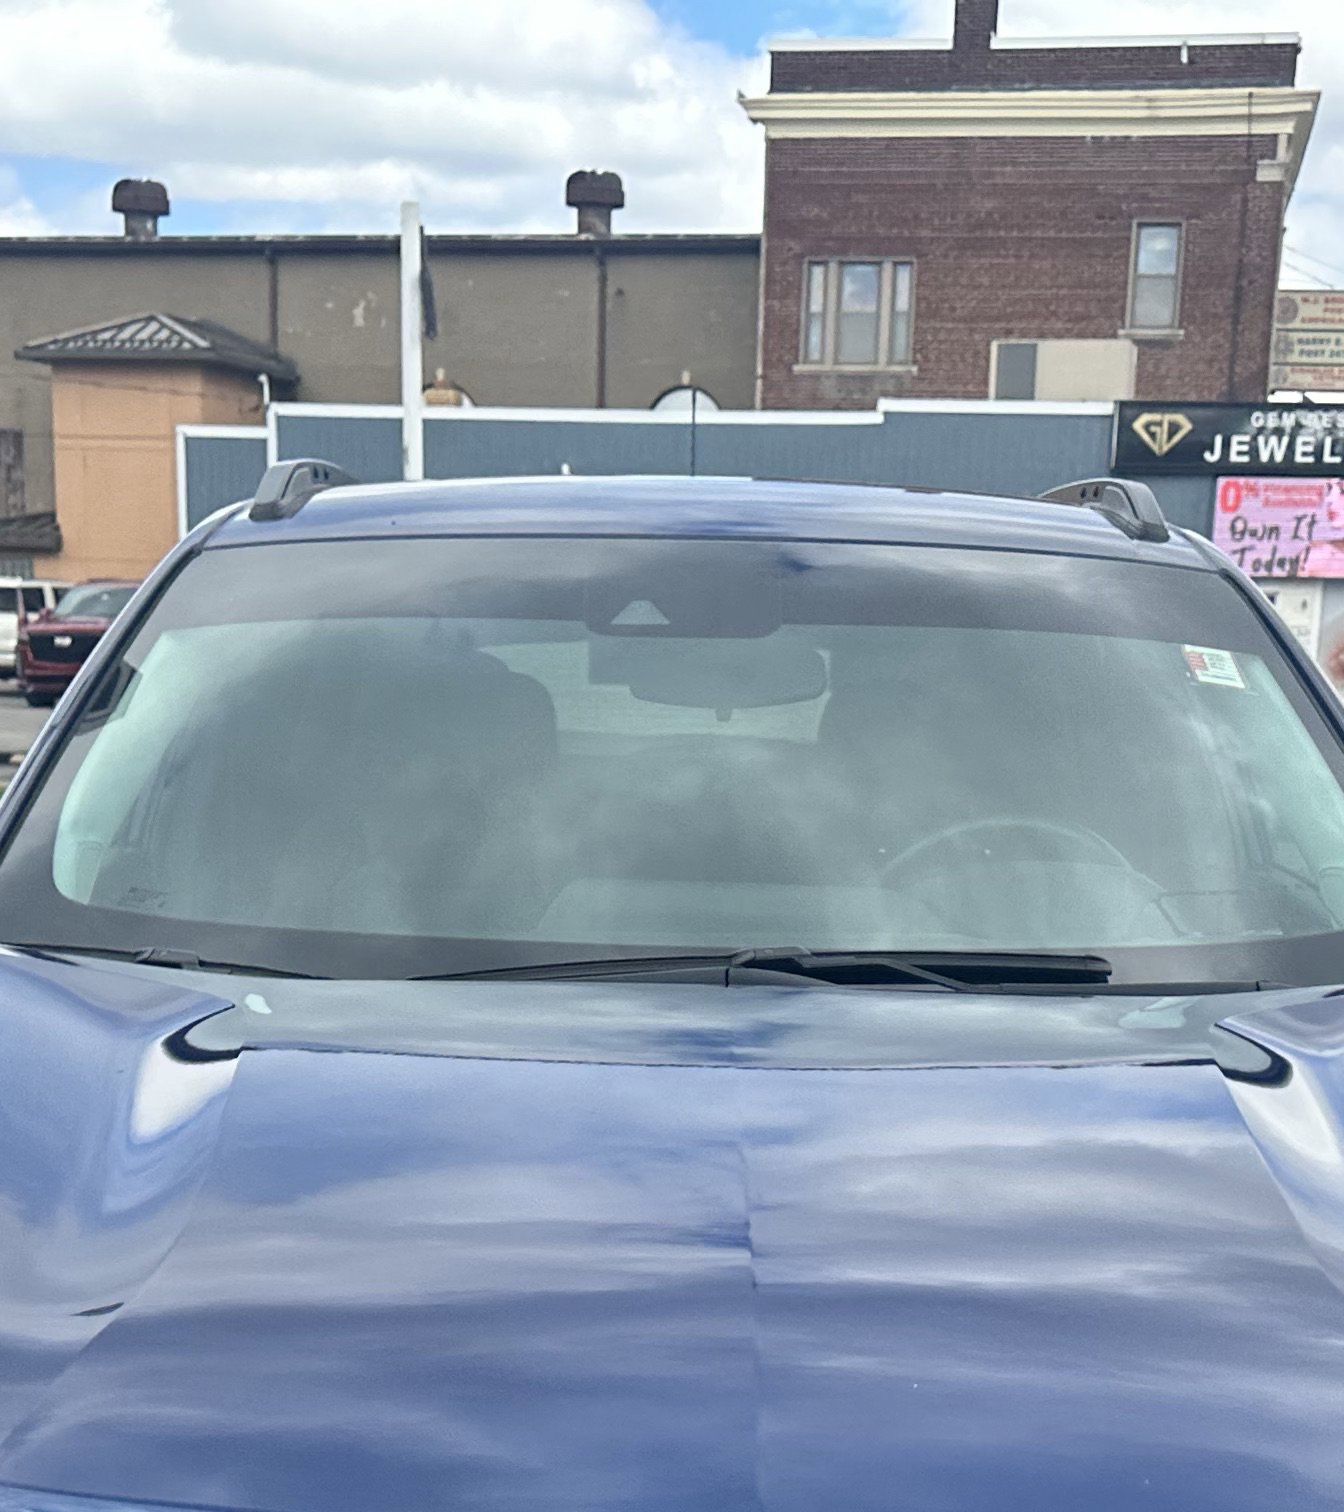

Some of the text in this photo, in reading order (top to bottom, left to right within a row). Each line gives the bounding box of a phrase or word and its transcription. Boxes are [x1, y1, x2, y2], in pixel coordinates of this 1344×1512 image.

[1249, 410, 1296, 429] GEM
[1229, 513, 1318, 543] Own It
[1231, 546, 1312, 578] Today!
